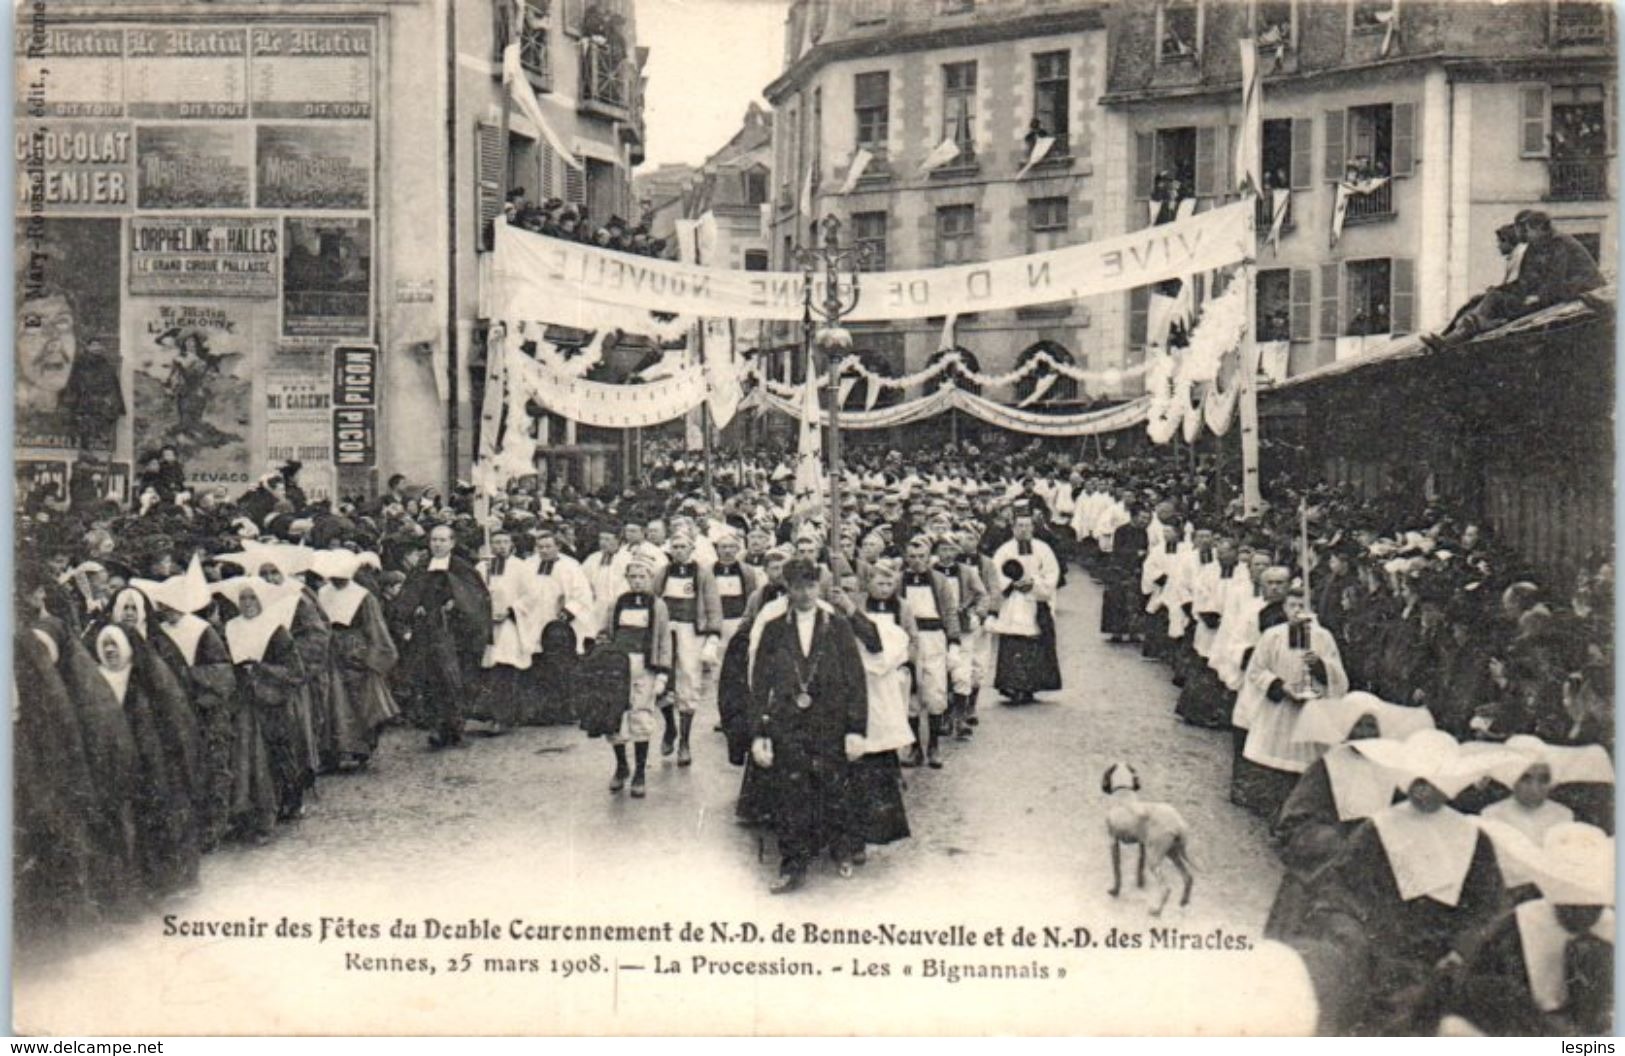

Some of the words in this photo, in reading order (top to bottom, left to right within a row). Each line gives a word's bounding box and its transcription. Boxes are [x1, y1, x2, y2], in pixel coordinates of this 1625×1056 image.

[43, 31, 120, 55] Matin
[127, 30, 155, 54] Le
[164, 30, 242, 54] Matin
[254, 30, 282, 54] Le
[290, 30, 367, 54] Matin
[57, 103, 79, 116] DIT
[84, 103, 123, 116] TOUT
[180, 104, 205, 116] DIT
[209, 104, 245, 116] TOUT
[304, 104, 329, 116] DIT
[333, 104, 370, 116] TOUT
[227, 226, 277, 253] HALLES
[137, 260, 149, 271] LE
[181, 305, 227, 318] Matin
[345, 352, 372, 403] PICON
[338, 410, 365, 463] PICON
